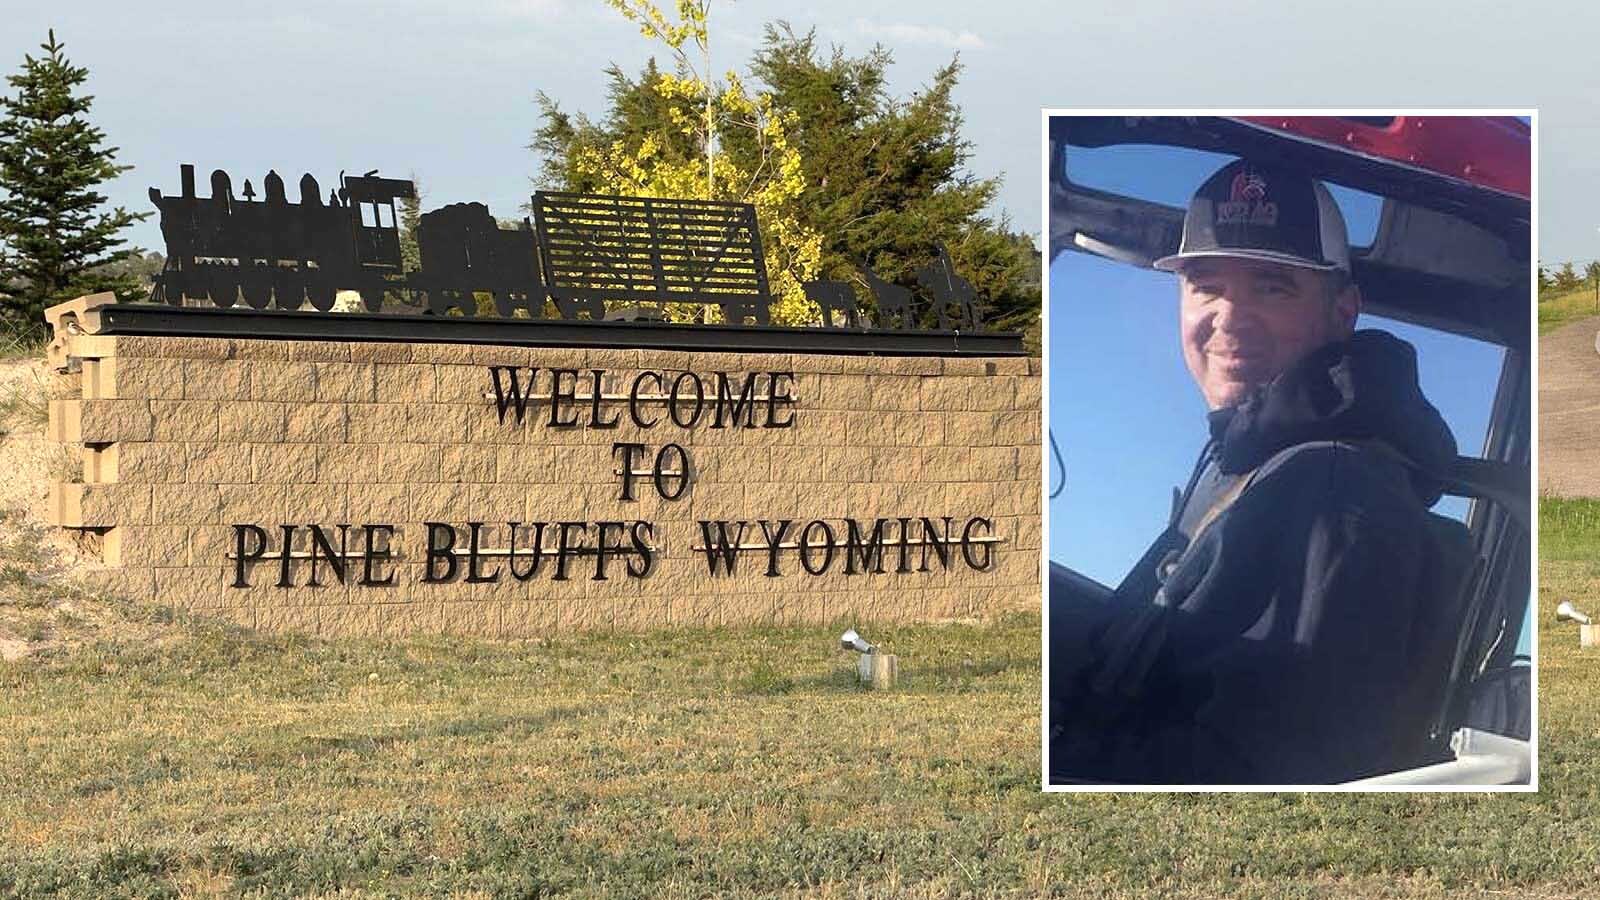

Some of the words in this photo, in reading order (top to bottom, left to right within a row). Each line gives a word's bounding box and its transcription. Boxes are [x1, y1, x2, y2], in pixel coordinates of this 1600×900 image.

[487, 365, 795, 430] WELCOME
[612, 442, 690, 501] TO
[230, 524, 396, 588] PINE
[420, 521, 654, 584] BLUFFS
[699, 516, 993, 577] WYOMING
